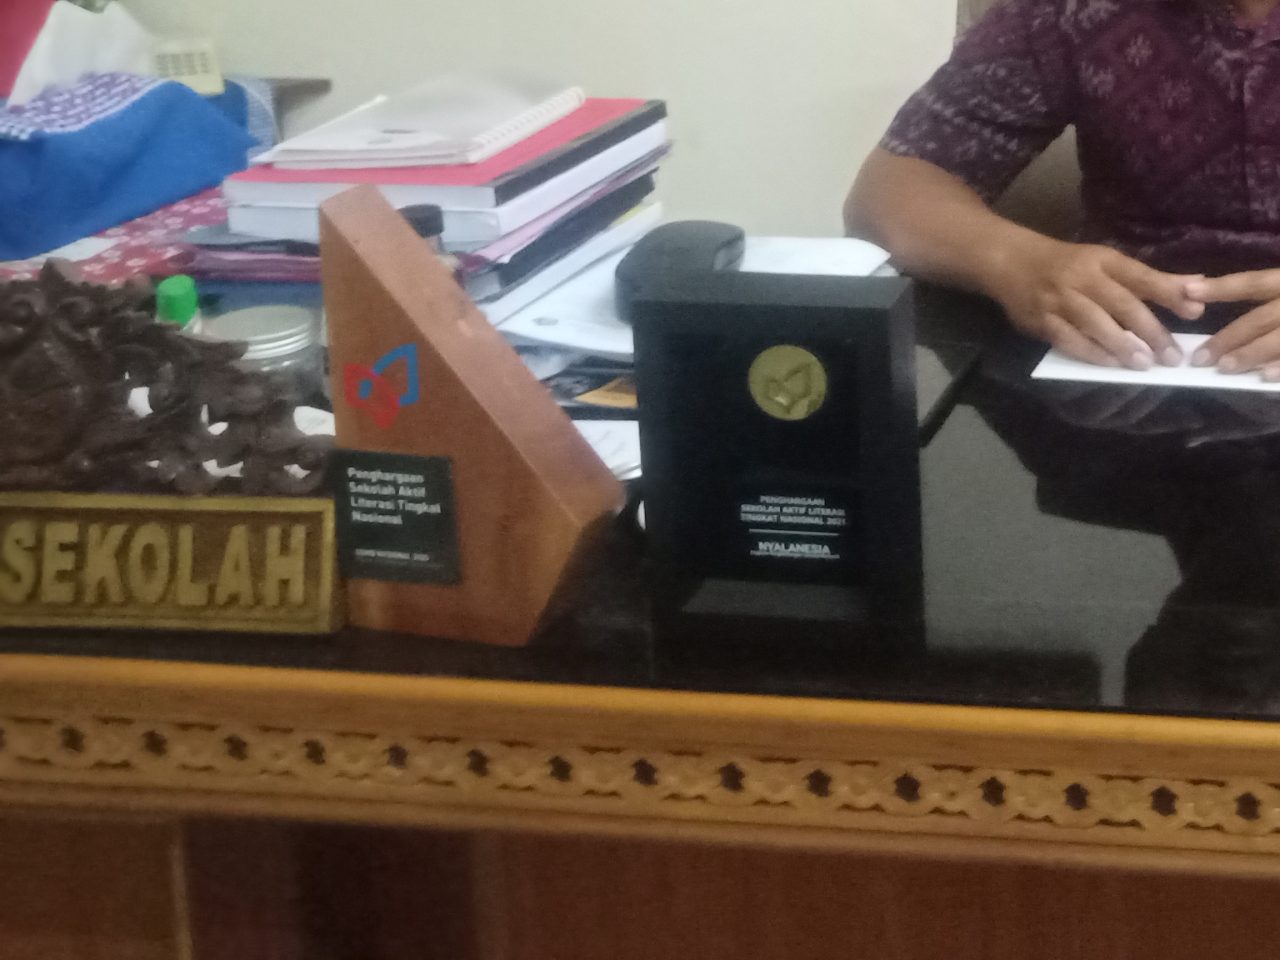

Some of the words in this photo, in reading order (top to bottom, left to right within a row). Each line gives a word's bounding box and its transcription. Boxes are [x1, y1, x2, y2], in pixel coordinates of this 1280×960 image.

[347, 467, 424, 484] Penghargaan
[349, 481, 396, 495] Sekolah
[398, 485, 426, 497] Aktif
[350, 496, 395, 510] Literasi
[398, 499, 441, 515] Tingkat
[759, 495, 826, 506] PENGHARGAAN
[740, 503, 781, 513] SEKOLAH
[782, 506, 807, 515] AKTIF
[808, 508, 846, 517] LITERASI
[351, 511, 403, 525] Nasional
[740, 512, 779, 522] TINGKAT
[780, 515, 825, 525] NASIONAL
[758, 541, 831, 554] NYALANESIA
[0, 518, 307, 607] SEKOLAH
